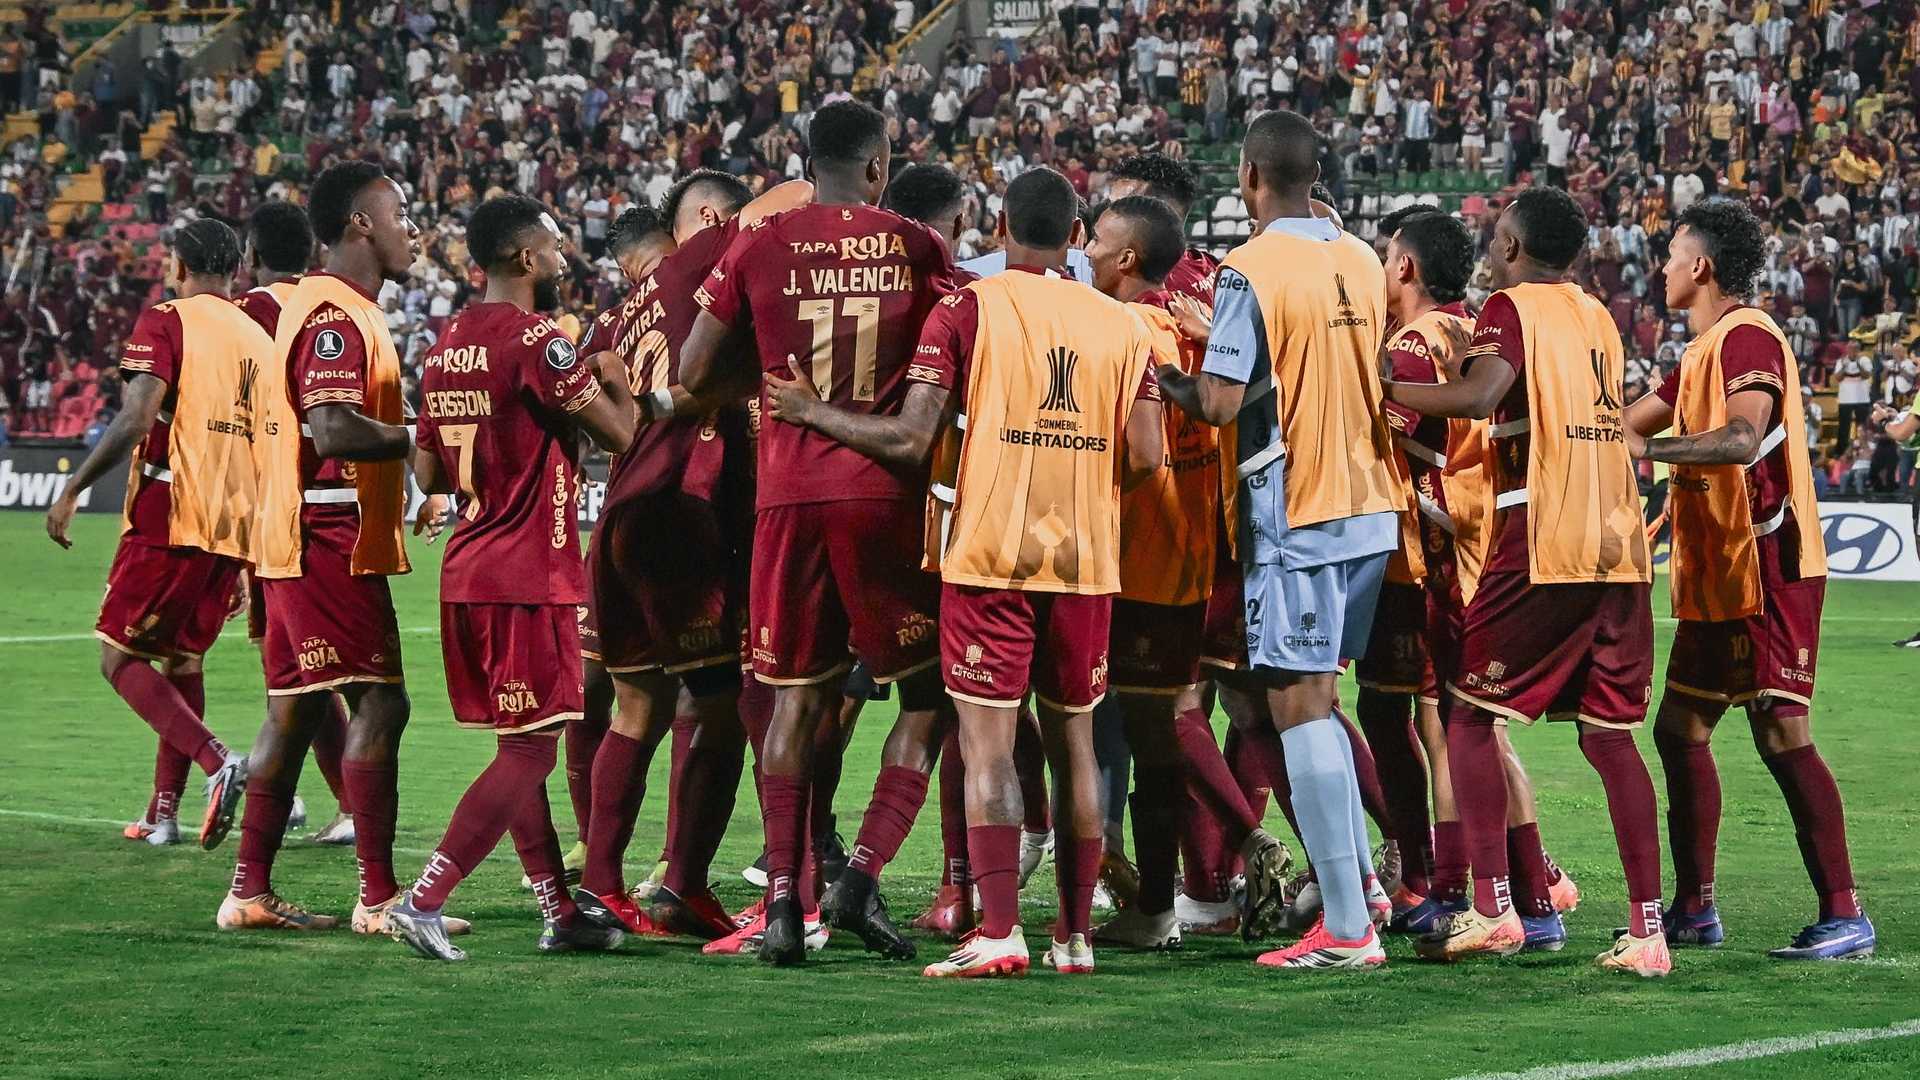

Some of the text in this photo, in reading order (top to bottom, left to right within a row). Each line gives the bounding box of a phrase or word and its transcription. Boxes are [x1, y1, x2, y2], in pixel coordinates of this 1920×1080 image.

[993, 1, 1040, 20] SALIDA
[790, 232, 908, 261] TAPA ROJA
[783, 264, 913, 296] J. VALENCIA
[443, 345, 489, 373] ROJA
[797, 296, 881, 402] 11
[316, 369, 357, 380] HOLCIM
[425, 390, 491, 418] JERSSON
[1000, 427, 1108, 452] LIBERTADORES
[438, 423, 481, 522] 7
[301, 638, 328, 649] TAPA
[1730, 634, 1750, 660] 10
[298, 646, 342, 672] ROJA
[503, 682, 527, 691] TAPA
[962, 670, 994, 684] TOLIMA
[498, 691, 540, 713] ROJA
